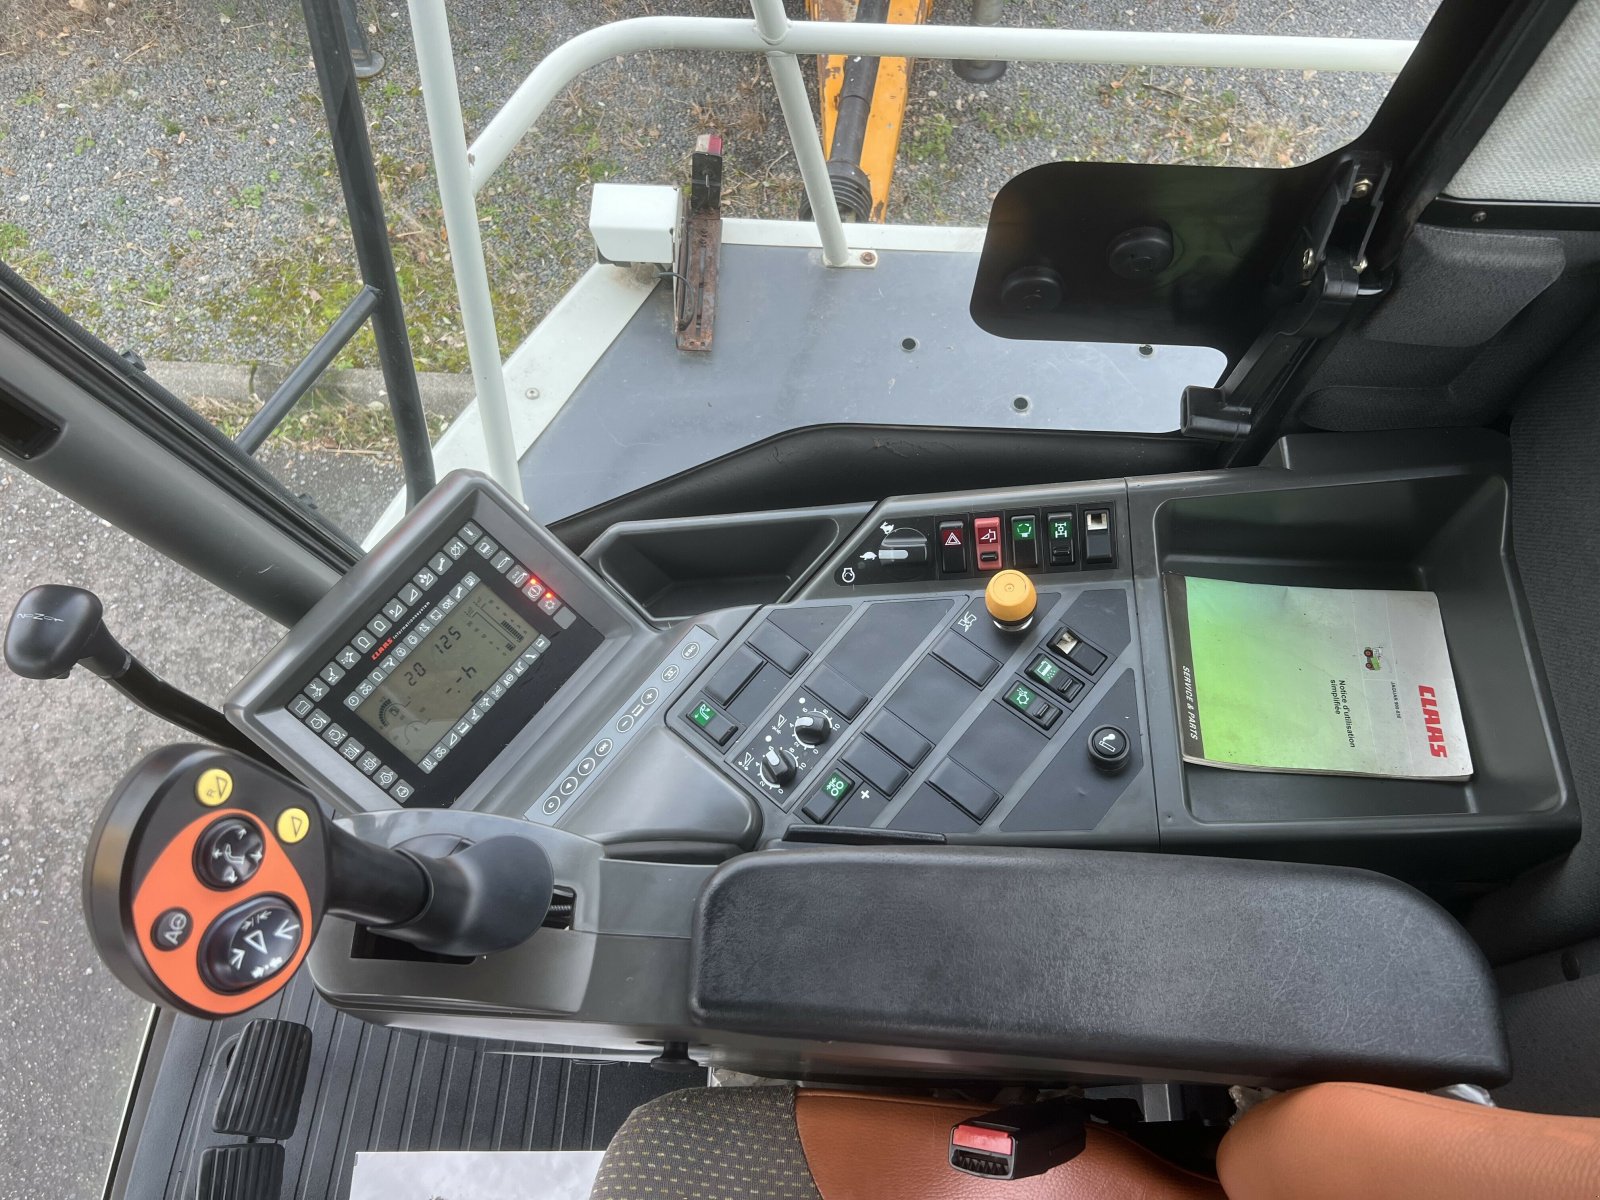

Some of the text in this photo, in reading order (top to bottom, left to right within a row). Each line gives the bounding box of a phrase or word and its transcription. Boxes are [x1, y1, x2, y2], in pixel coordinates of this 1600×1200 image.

[832, 723, 841, 731] 10
[1182, 665, 1198, 740] SERVICE & PARTS
[1330, 679, 1341, 715] simplifiée
[1339, 679, 1355, 748] Notice d'utilisation
[1418, 684, 1448, 759] CLAAS
